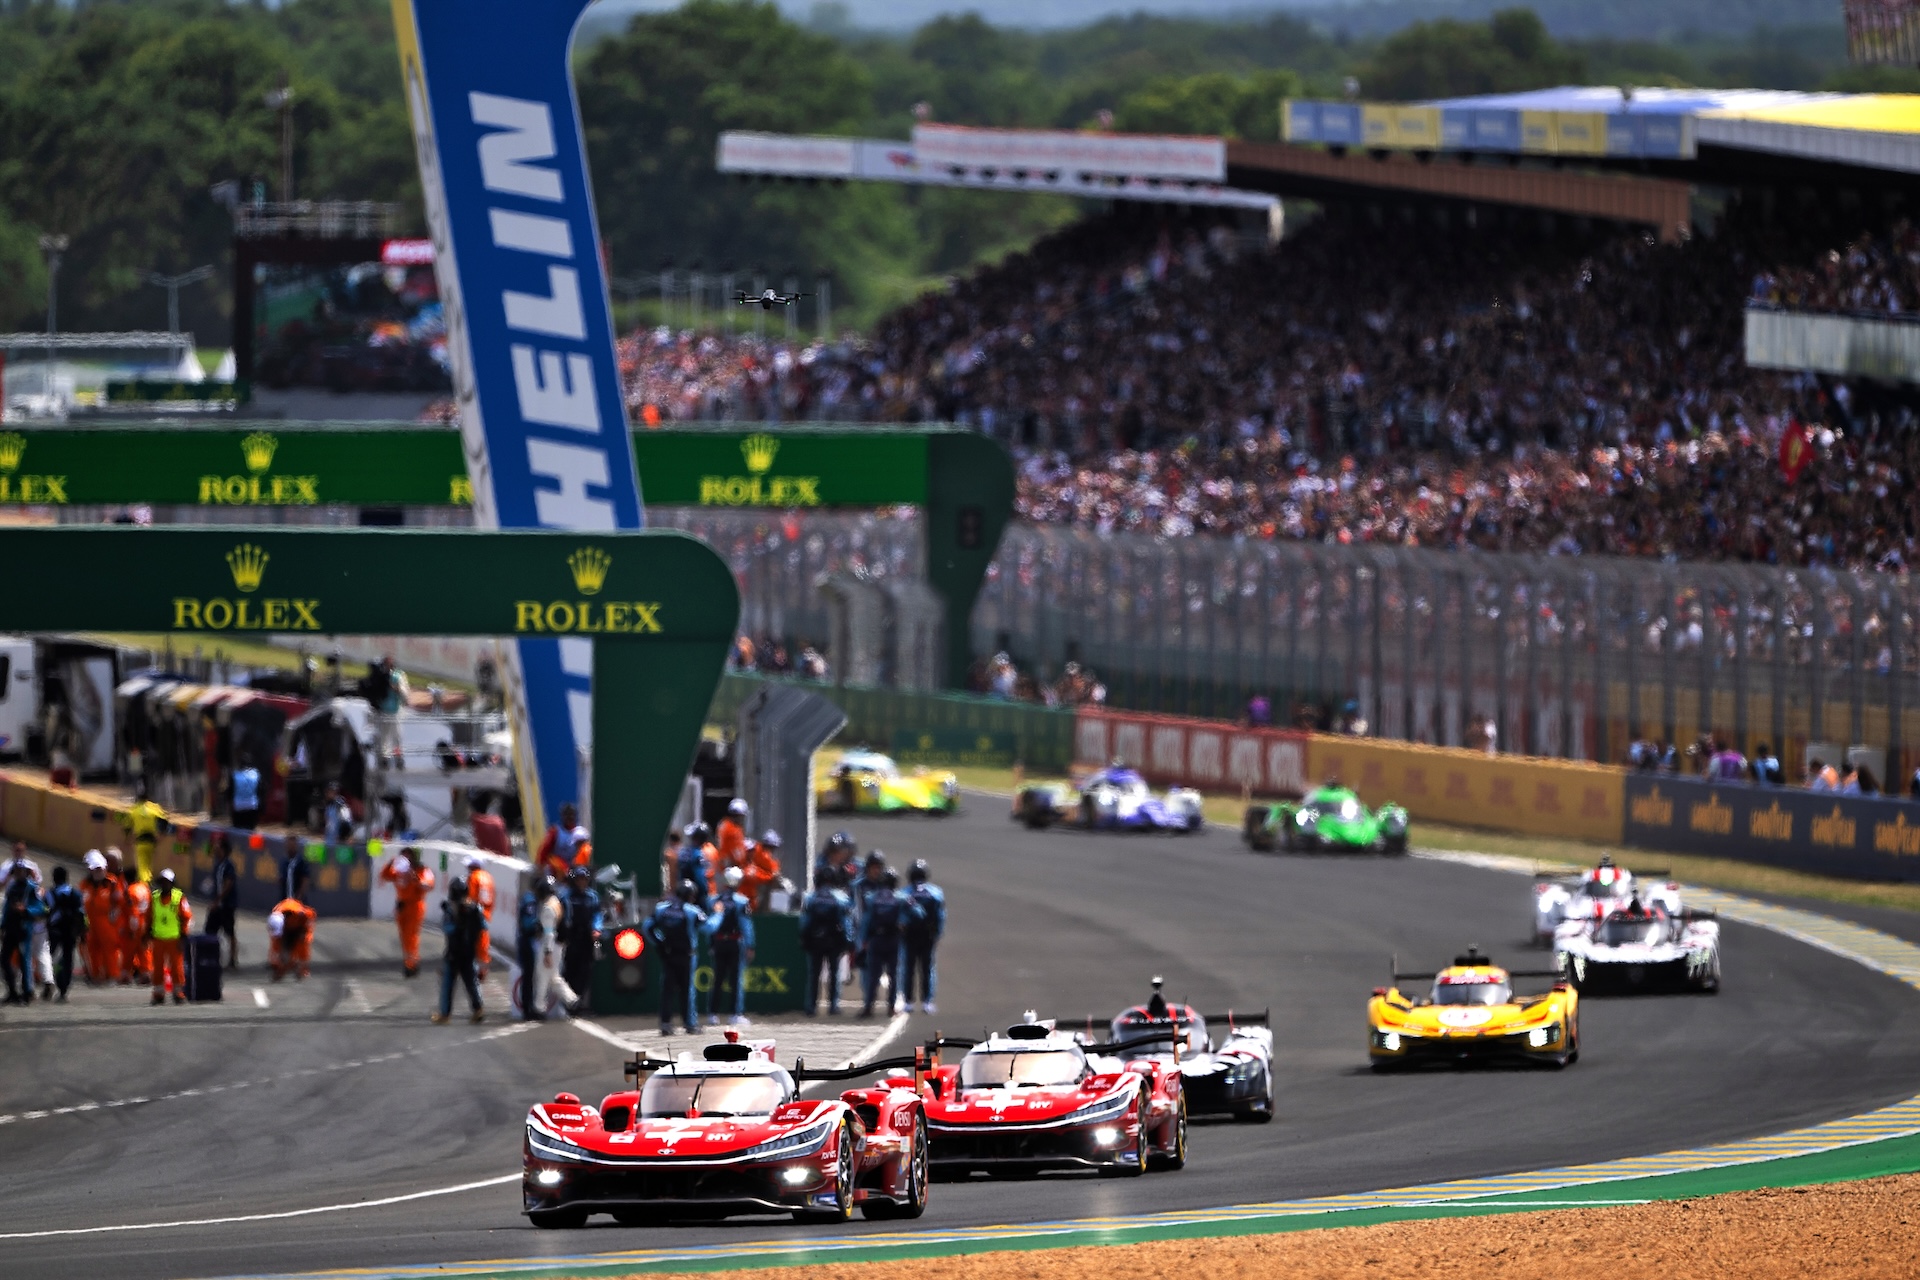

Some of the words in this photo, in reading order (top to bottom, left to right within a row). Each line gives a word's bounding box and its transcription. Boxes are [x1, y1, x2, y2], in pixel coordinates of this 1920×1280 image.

[469, 90, 619, 744] HELIN
[0, 475, 69, 503] LEX
[199, 475, 319, 505] ROLEX
[699, 475, 821, 505] ROLEX
[173, 598, 321, 630] ROLEX
[515, 601, 663, 633] ROLEX
[693, 965, 789, 993] OEX
[551, 1113, 583, 1121] CASIO
[894, 1111, 911, 1127] DENSO
[706, 1132, 733, 1141] HY
